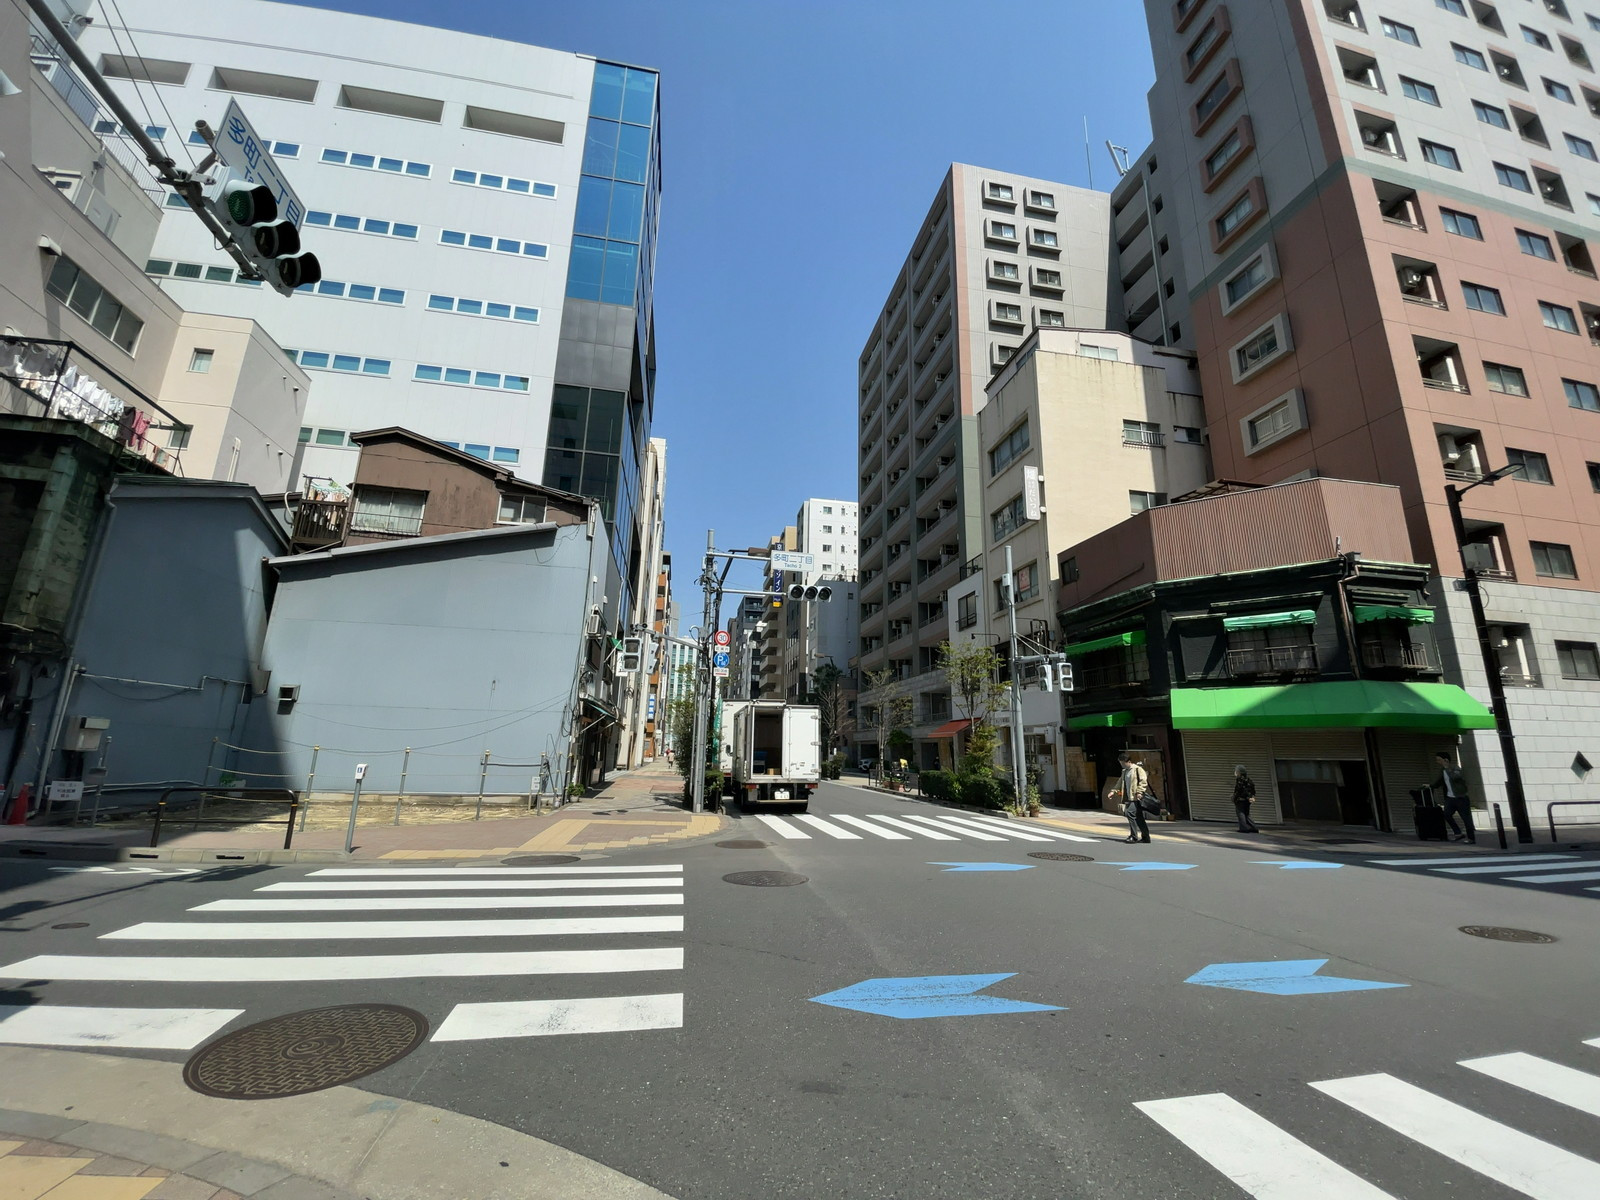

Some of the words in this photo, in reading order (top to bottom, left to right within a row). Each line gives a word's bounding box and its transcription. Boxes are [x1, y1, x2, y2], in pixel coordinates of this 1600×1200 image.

[227, 115, 301, 227] 多町二丁目
[773, 553, 813, 565] 多町二丁目
[719, 634, 727, 642] 30
[717, 655, 724, 666] P
